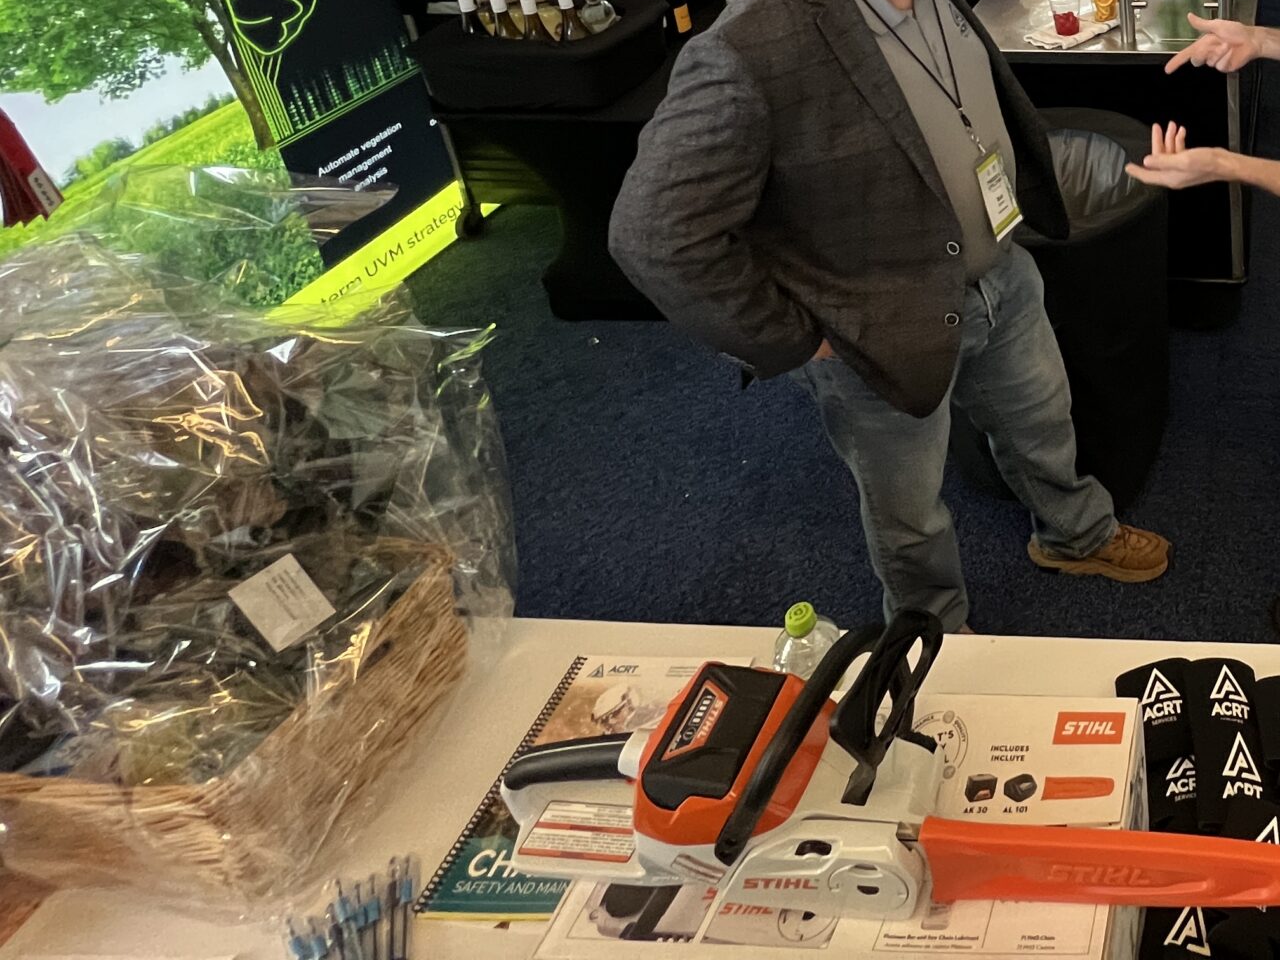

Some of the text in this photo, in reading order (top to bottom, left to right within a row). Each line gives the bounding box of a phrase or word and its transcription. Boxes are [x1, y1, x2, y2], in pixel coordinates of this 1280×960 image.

[318, 120, 402, 178] Automate vegetation
[338, 144, 393, 184] management
[354, 166, 388, 192] analysis
[364, 243, 405, 278] UVM
[406, 201, 465, 250] strategy
[607, 665, 640, 674] ACRT
[696, 699, 724, 738] STIHL
[1143, 700, 1183, 722] ACRT
[1211, 702, 1250, 720] ACRT
[1061, 720, 1117, 736] STIHL
[1151, 716, 1178, 726] SERVICES
[990, 745, 1030, 753] INCLUDES
[990, 754, 1025, 762] INCLUYE
[963, 806, 988, 814] AK 30
[1015, 805, 1028, 813] 101
[467, 848, 532, 878] CH
[1047, 864, 1151, 886] STIHL
[452, 880, 507, 894] SAFETY
[504, 881, 536, 895] AND
[743, 878, 818, 890] STIHL
[718, 902, 773, 916] STIHL
